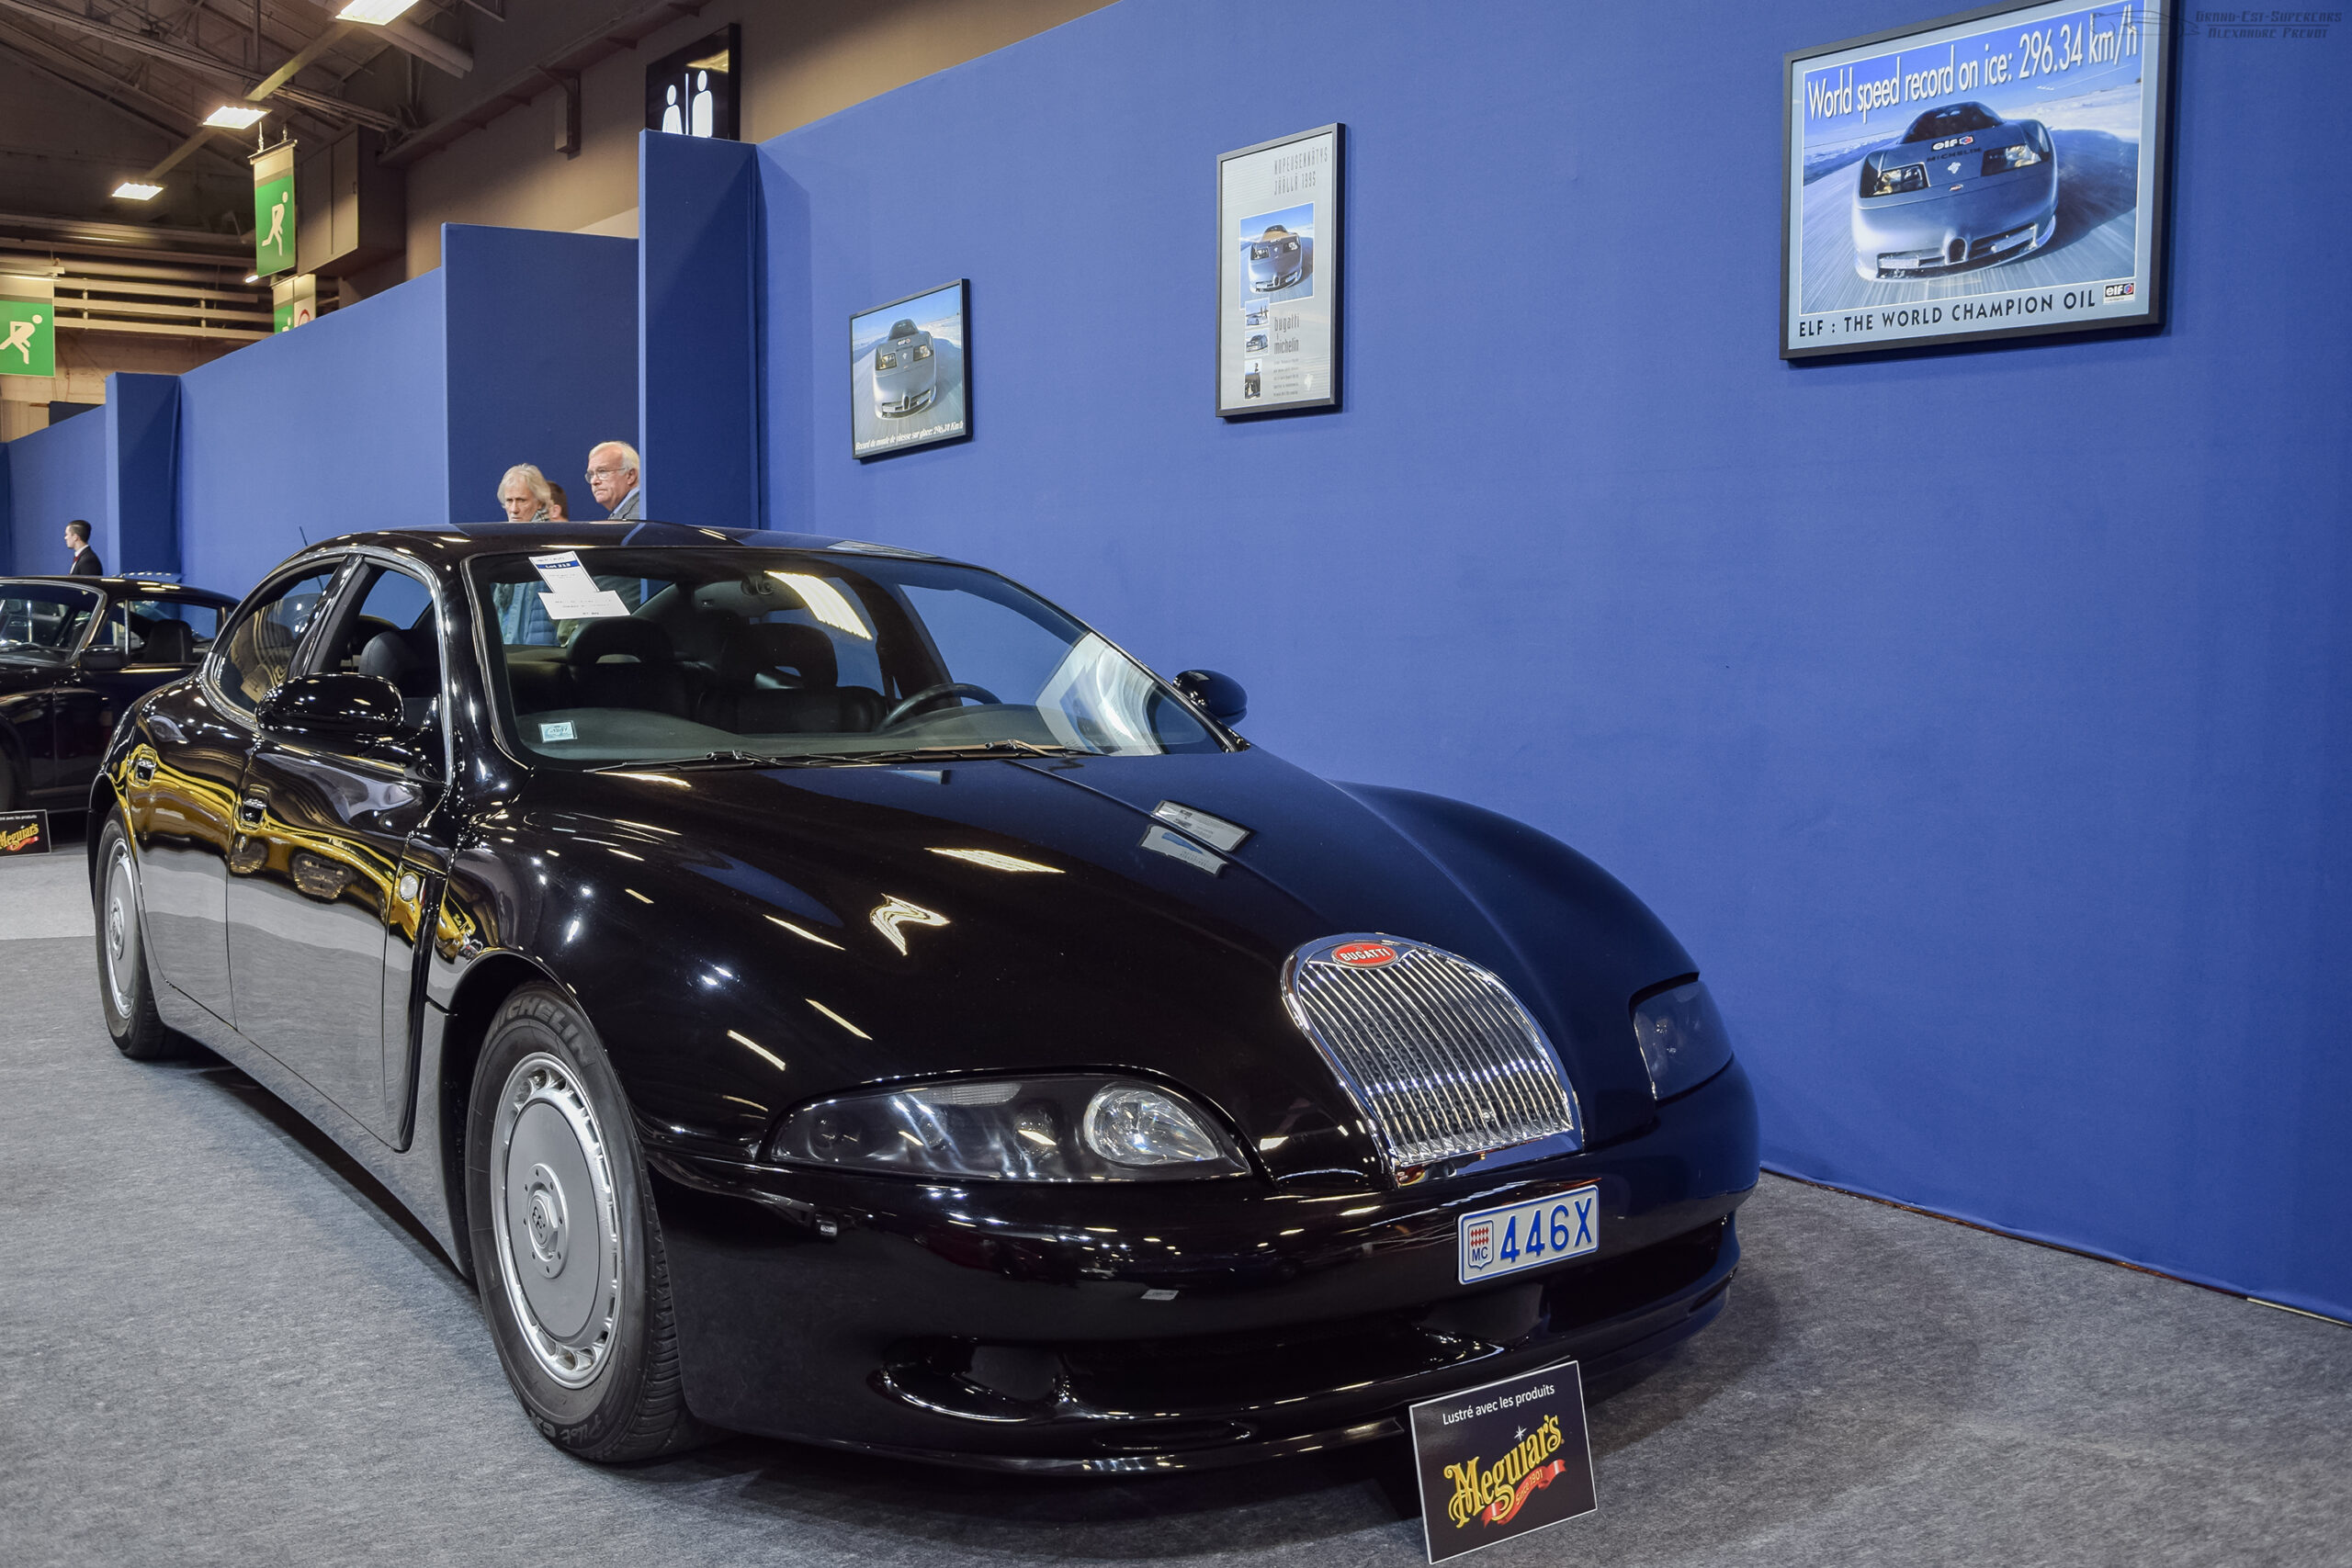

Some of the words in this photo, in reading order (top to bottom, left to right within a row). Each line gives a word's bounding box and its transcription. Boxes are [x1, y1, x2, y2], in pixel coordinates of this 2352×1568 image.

[1808, 66, 1853, 120] World
[1857, 56, 1901, 124] speed
[1905, 44, 1956, 99] record
[1959, 57, 1979, 92] on
[1984, 43, 2013, 86] ice:
[2019, 21, 2084, 79] 296.34
[2089, 4, 2138, 66] km/h
[1932, 138, 1959, 151] elf
[1927, 147, 1982, 163] MICHELIN
[2106, 285, 2123, 297] elf
[1274, 313, 1300, 333] bugatti
[1799, 319, 1825, 338] ELF
[1844, 313, 1874, 333] THE
[1882, 306, 1943, 329] WORLD
[1951, 294, 2054, 322] CHAMPION
[2064, 289, 2097, 310] OIL
[1274, 337, 1299, 355] michelin
[1340, 948, 1391, 962] BUGATTI
[1500, 1197, 1592, 1263] 446X
[1472, 1247, 1488, 1262] MC
[1442, 1404, 1474, 1426] Lustré
[1476, 1401, 1498, 1416] avec
[1499, 1396, 1514, 1409] les
[1516, 1384, 1555, 1407] produits
[1443, 1414, 1562, 1528] Meguiar's
[1516, 1483, 1531, 1506] Since
[1529, 1469, 1544, 1486] 1901
